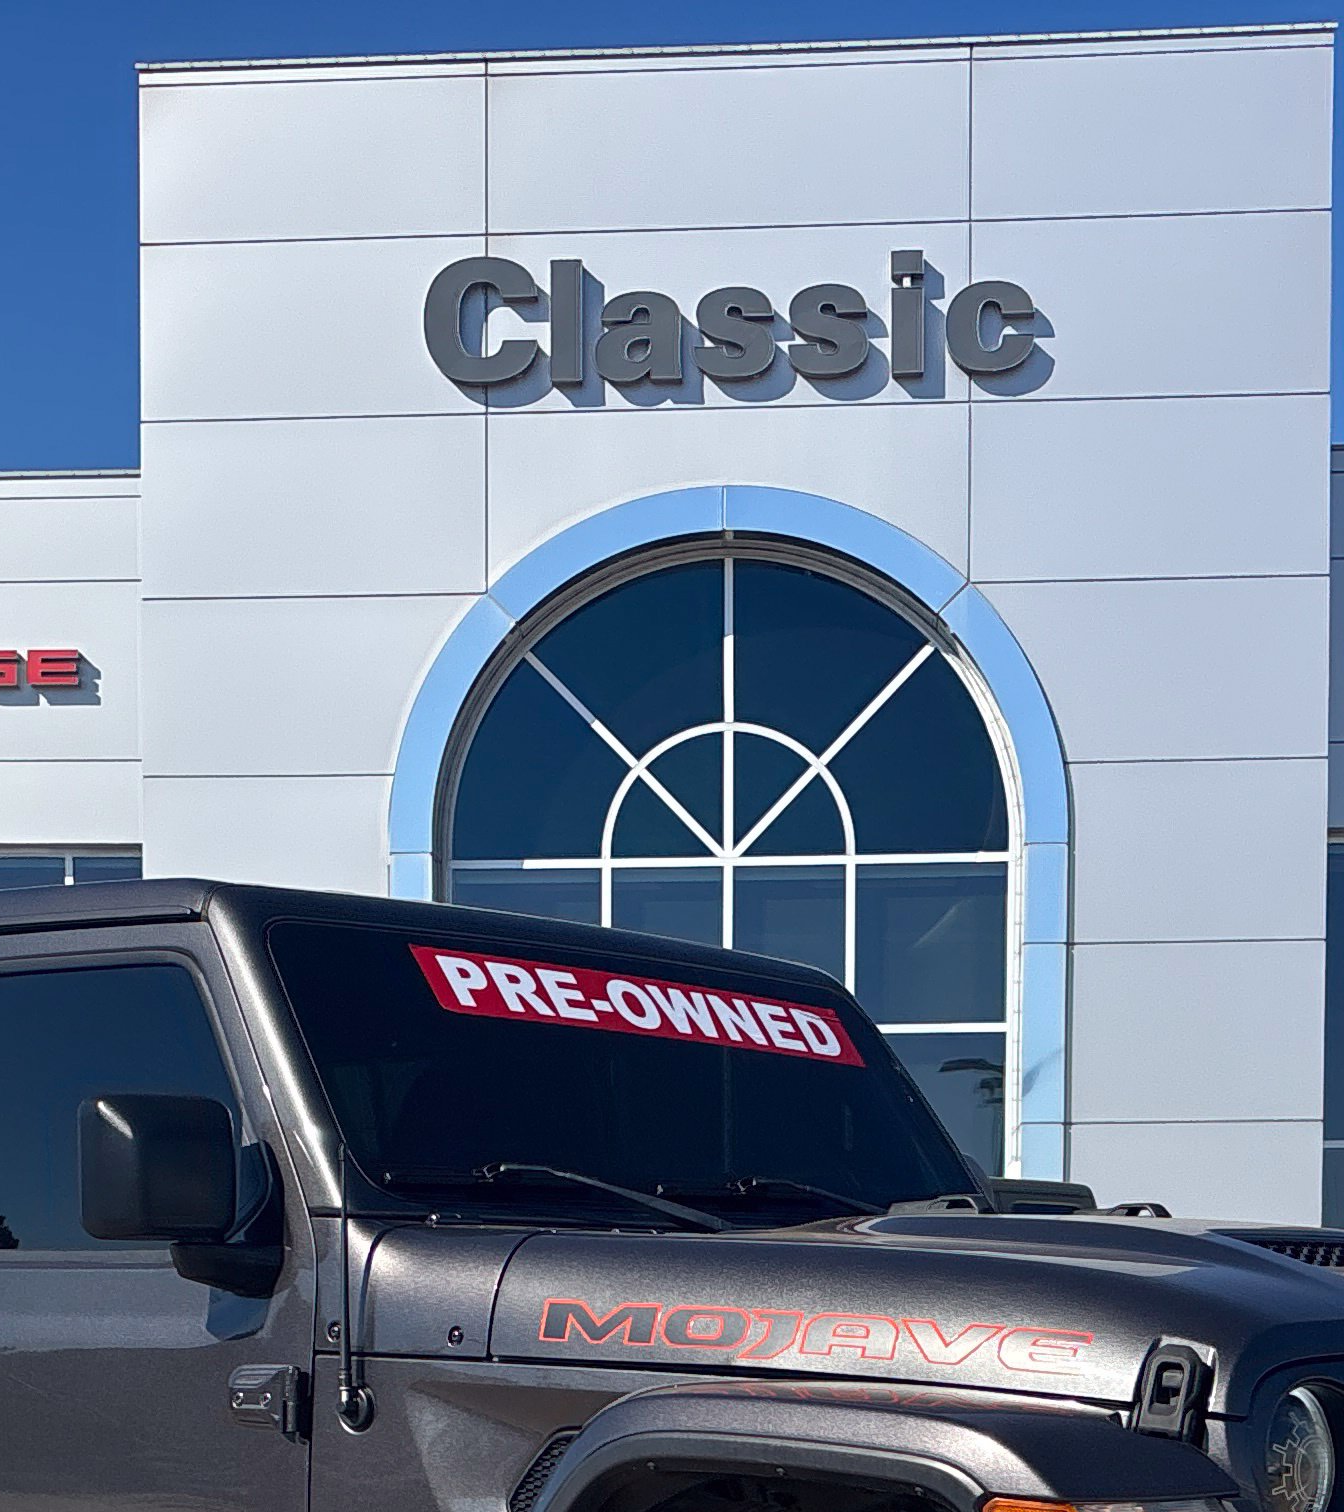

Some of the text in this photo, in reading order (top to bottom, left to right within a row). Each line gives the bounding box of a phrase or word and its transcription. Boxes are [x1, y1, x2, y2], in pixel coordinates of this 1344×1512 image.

[424, 250, 1036, 386] Classic
[435, 953, 842, 1057] PRE-OWNED
[538, 1298, 1094, 1376] MOJAVE
